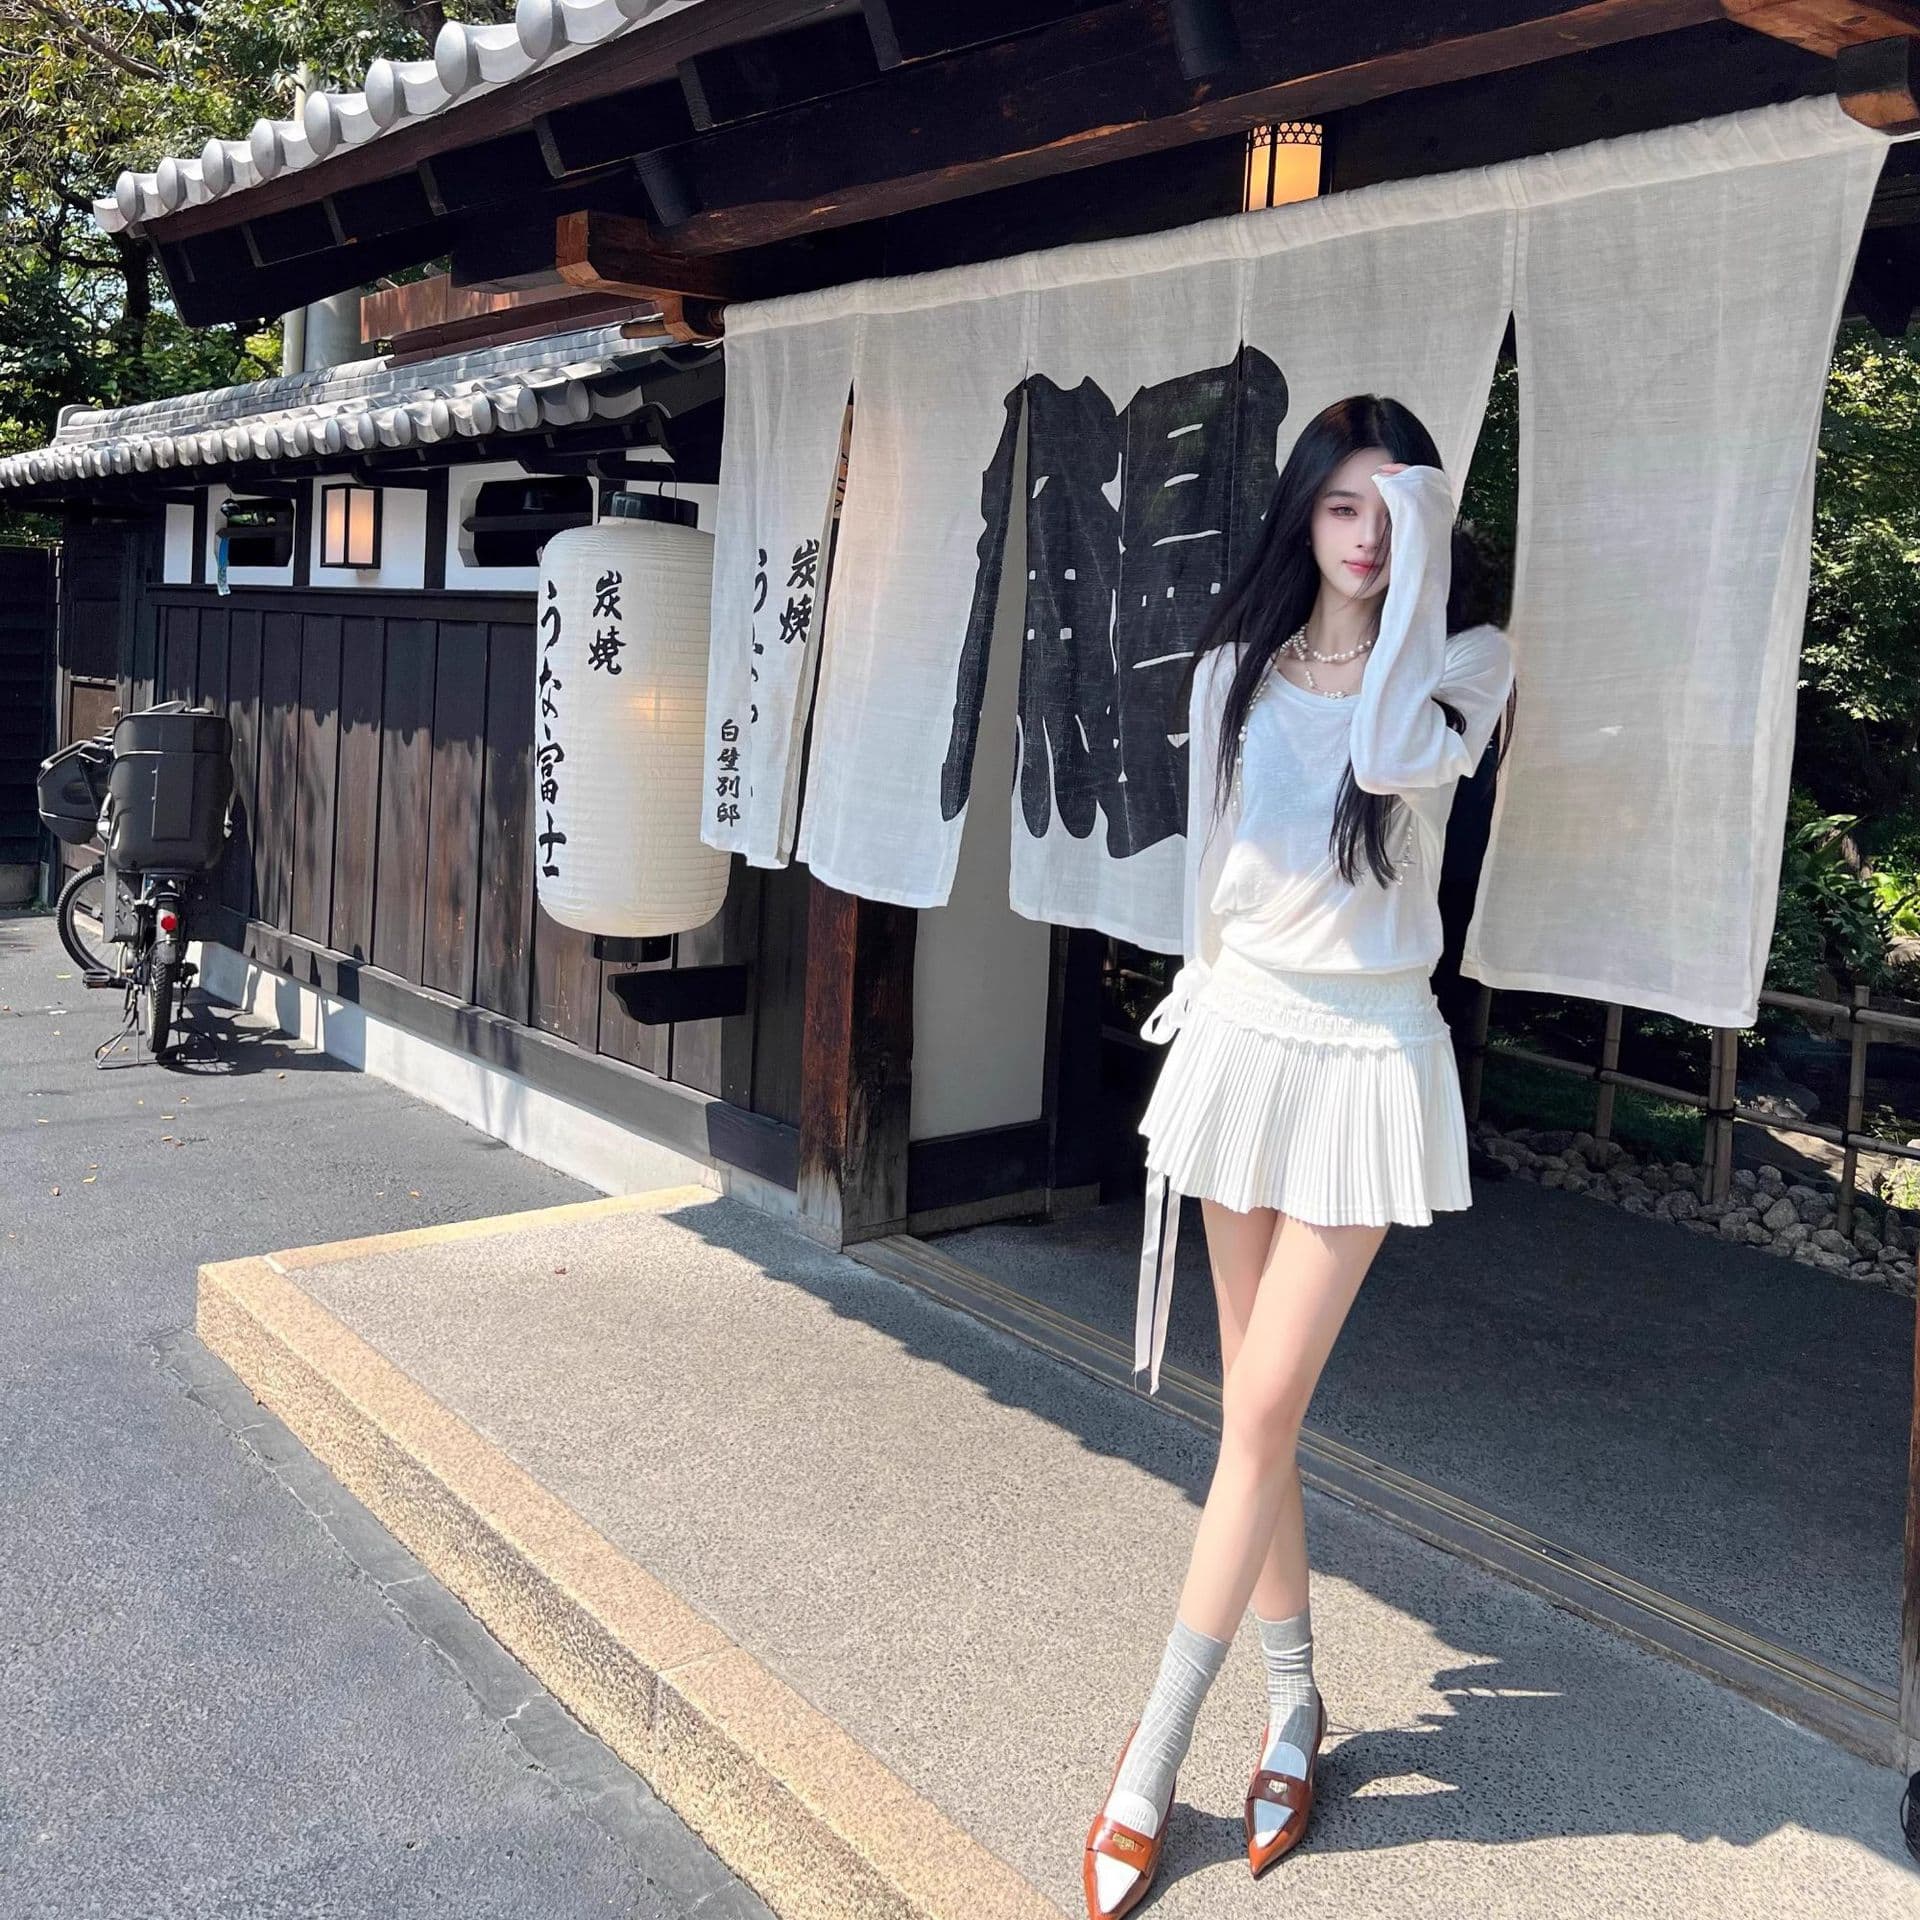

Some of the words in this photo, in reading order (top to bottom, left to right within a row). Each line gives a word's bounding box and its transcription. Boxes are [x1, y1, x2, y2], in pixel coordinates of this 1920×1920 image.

[588, 569, 627, 676] 炭焼
[779, 538, 820, 644] 炭焼
[536, 580, 567, 879] うな富士
[716, 718, 741, 827] 白壁別邸
